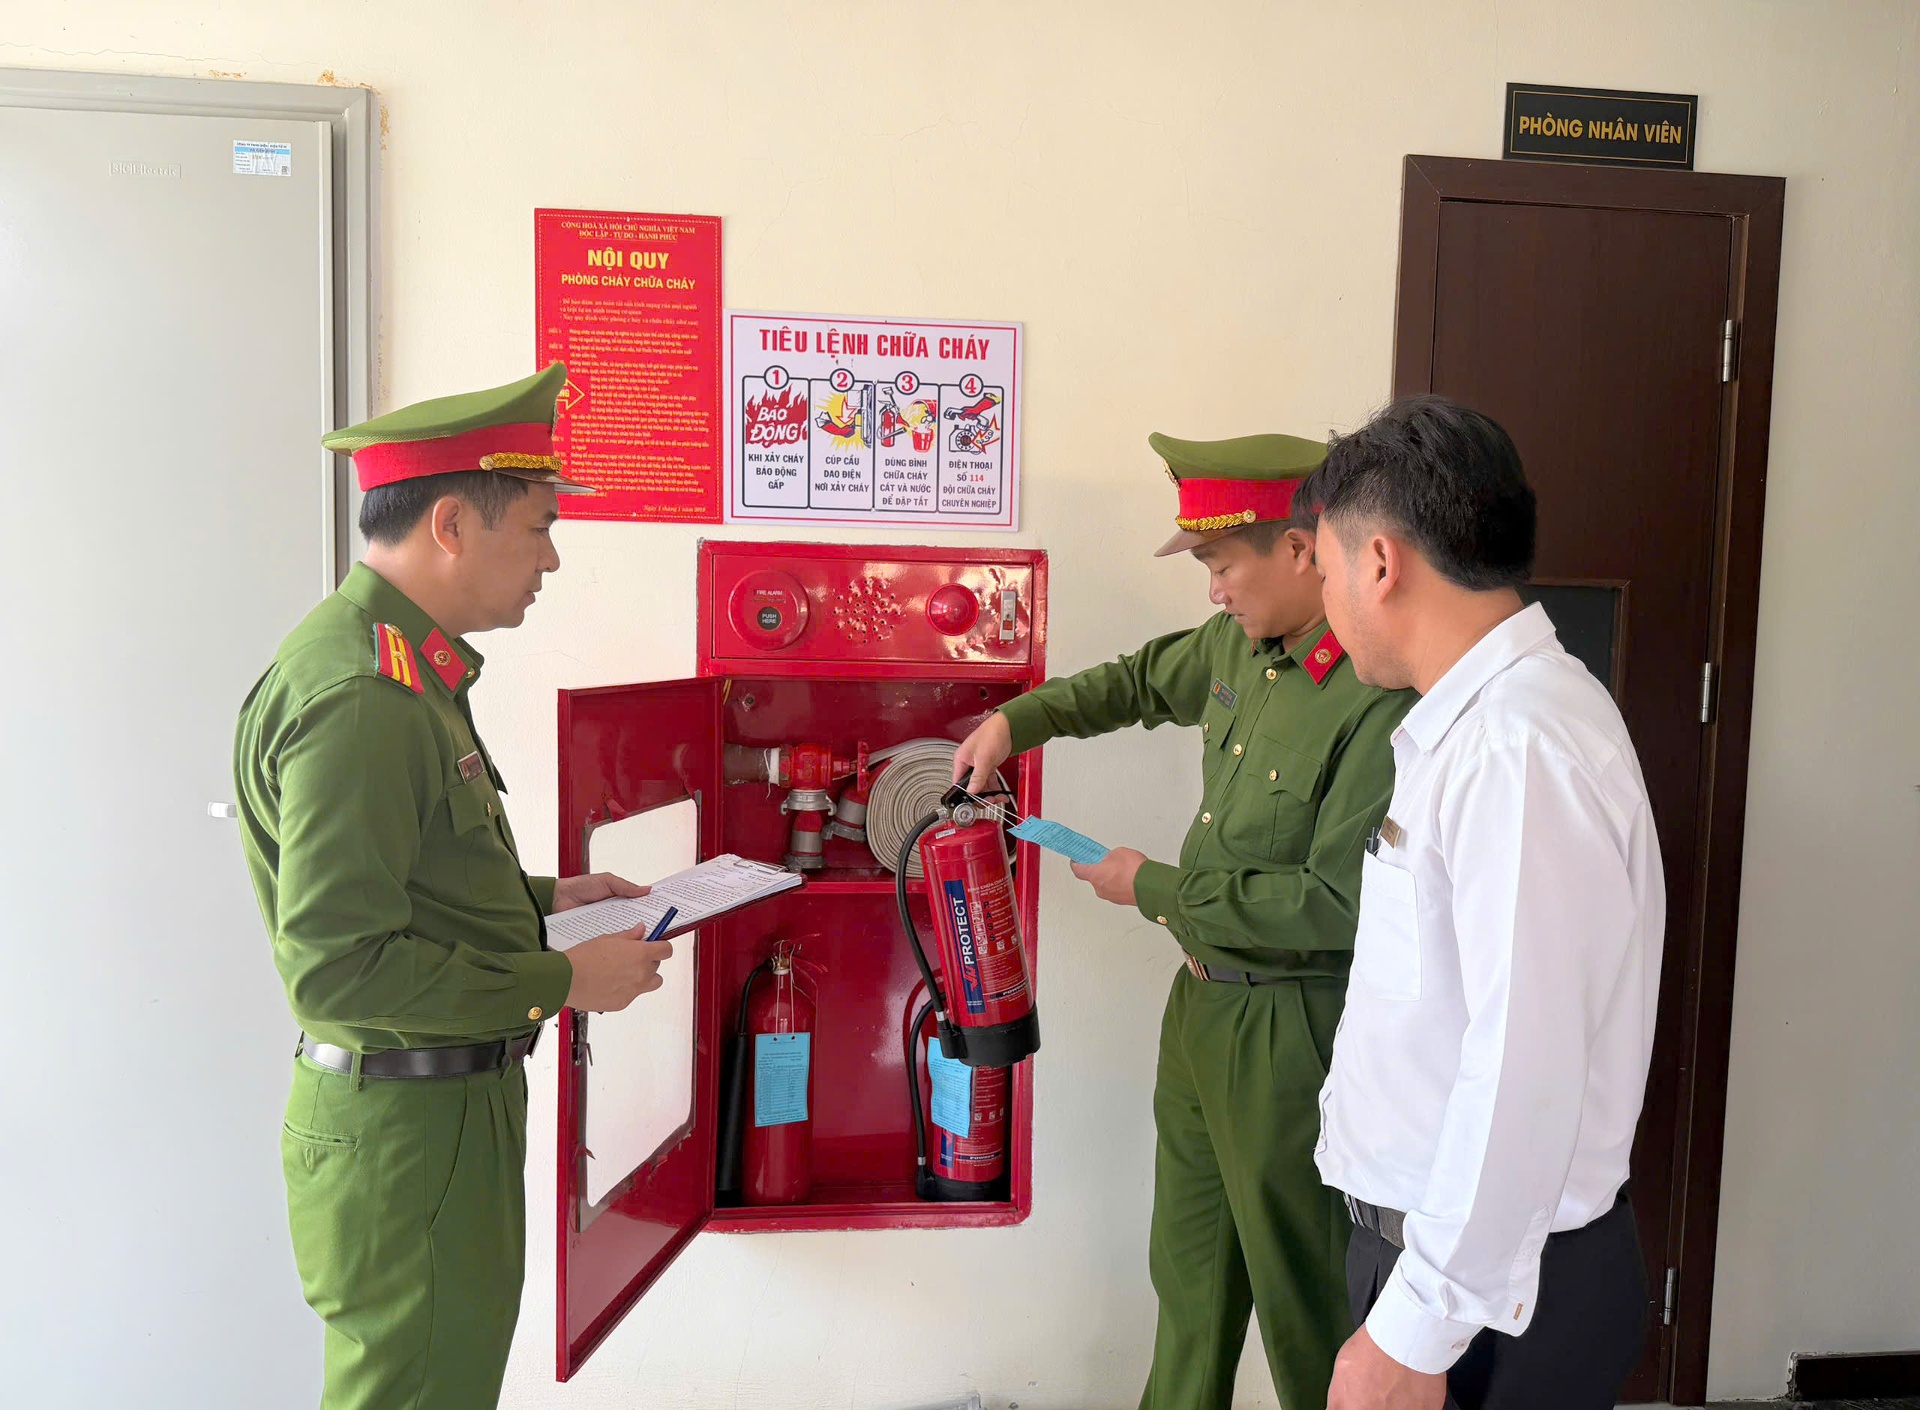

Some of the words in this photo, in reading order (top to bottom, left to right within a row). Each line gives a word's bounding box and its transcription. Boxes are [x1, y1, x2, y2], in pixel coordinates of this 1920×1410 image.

[1518, 112, 1583, 138] PHÒNG
[1588, 117, 1638, 141] NHÂN
[1644, 120, 1682, 144] VIÊN
[588, 246, 622, 270] NỘI
[630, 251, 669, 270] QUY
[562, 273, 598, 286] PHÒNG
[602, 274, 630, 287] CHÁY
[634, 275, 663, 288] CHỮA
[667, 277, 696, 290] CHÁY
[760, 326, 807, 352] TIÊU
[816, 328, 868, 358] LỆNH
[877, 332, 928, 358] CHỮA
[939, 334, 990, 360] CHÁY
[772, 370, 779, 385] 1
[836, 372, 848, 388] 2
[902, 374, 913, 391] 3
[965, 378, 976, 394] 4
[757, 404, 787, 422] BÁO
[750, 422, 798, 446] ĐỘNG
[748, 454, 762, 462] KHI
[765, 452, 780, 462] XẢY
[782, 454, 804, 463] CHÁY
[826, 455, 841, 464] CÚP
[885, 457, 906, 467] DÙNG
[909, 458, 927, 467] BÌNH
[756, 466, 772, 476] BÁO
[775, 466, 796, 477] ĐỘNG
[949, 460, 967, 470] ĐIỆN
[970, 461, 992, 471] THOẠI
[824, 470, 840, 478] DAO
[842, 469, 860, 480] ĐIỆN
[884, 470, 904, 479] CHỮA
[907, 471, 928, 480] CHÁY
[957, 471, 967, 481] SỐ
[768, 478, 784, 490] GẤP
[814, 482, 828, 491] NƠI
[830, 480, 846, 492] XẢY
[848, 482, 869, 492] CHÁY
[880, 482, 894, 492] CÁT
[898, 484, 908, 492] VÀ
[910, 484, 931, 493] NƯỚC
[943, 486, 955, 494] ĐỘI
[957, 485, 976, 494] CHỮA
[978, 486, 996, 494] CHÁY
[882, 494, 892, 505] ĐỂ
[896, 496, 912, 507] DẬP
[942, 498, 969, 507] CHUYÊN
[972, 500, 996, 508] NGHIỆP
[953, 898, 974, 965] PROTECT
